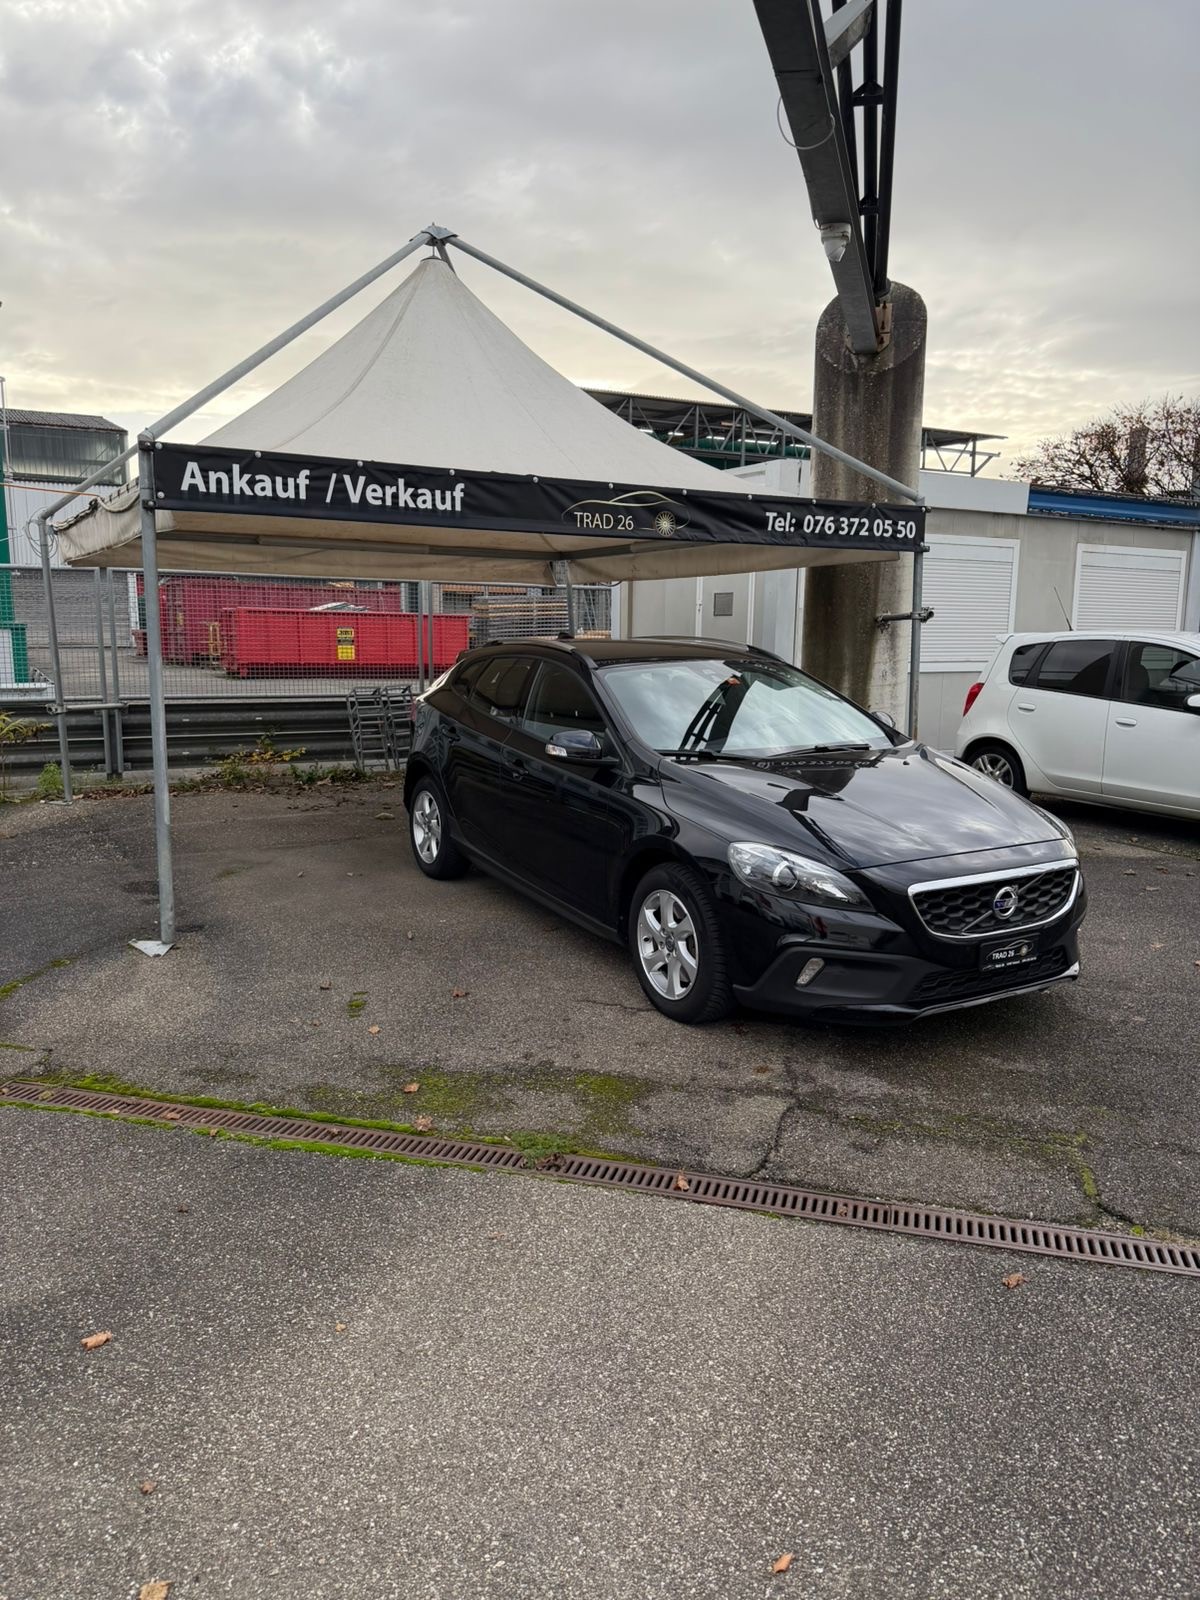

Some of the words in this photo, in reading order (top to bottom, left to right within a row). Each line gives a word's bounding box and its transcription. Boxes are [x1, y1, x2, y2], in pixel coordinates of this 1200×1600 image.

[180, 461, 311, 500] Ankauf
[573, 511, 614, 529] TRAD
[617, 515, 634, 531] 26
[765, 512, 796, 533] Tel:
[803, 514, 835, 535] 076
[838, 517, 869, 536] 372
[873, 519, 893, 538] 05
[896, 521, 916, 539] 50
